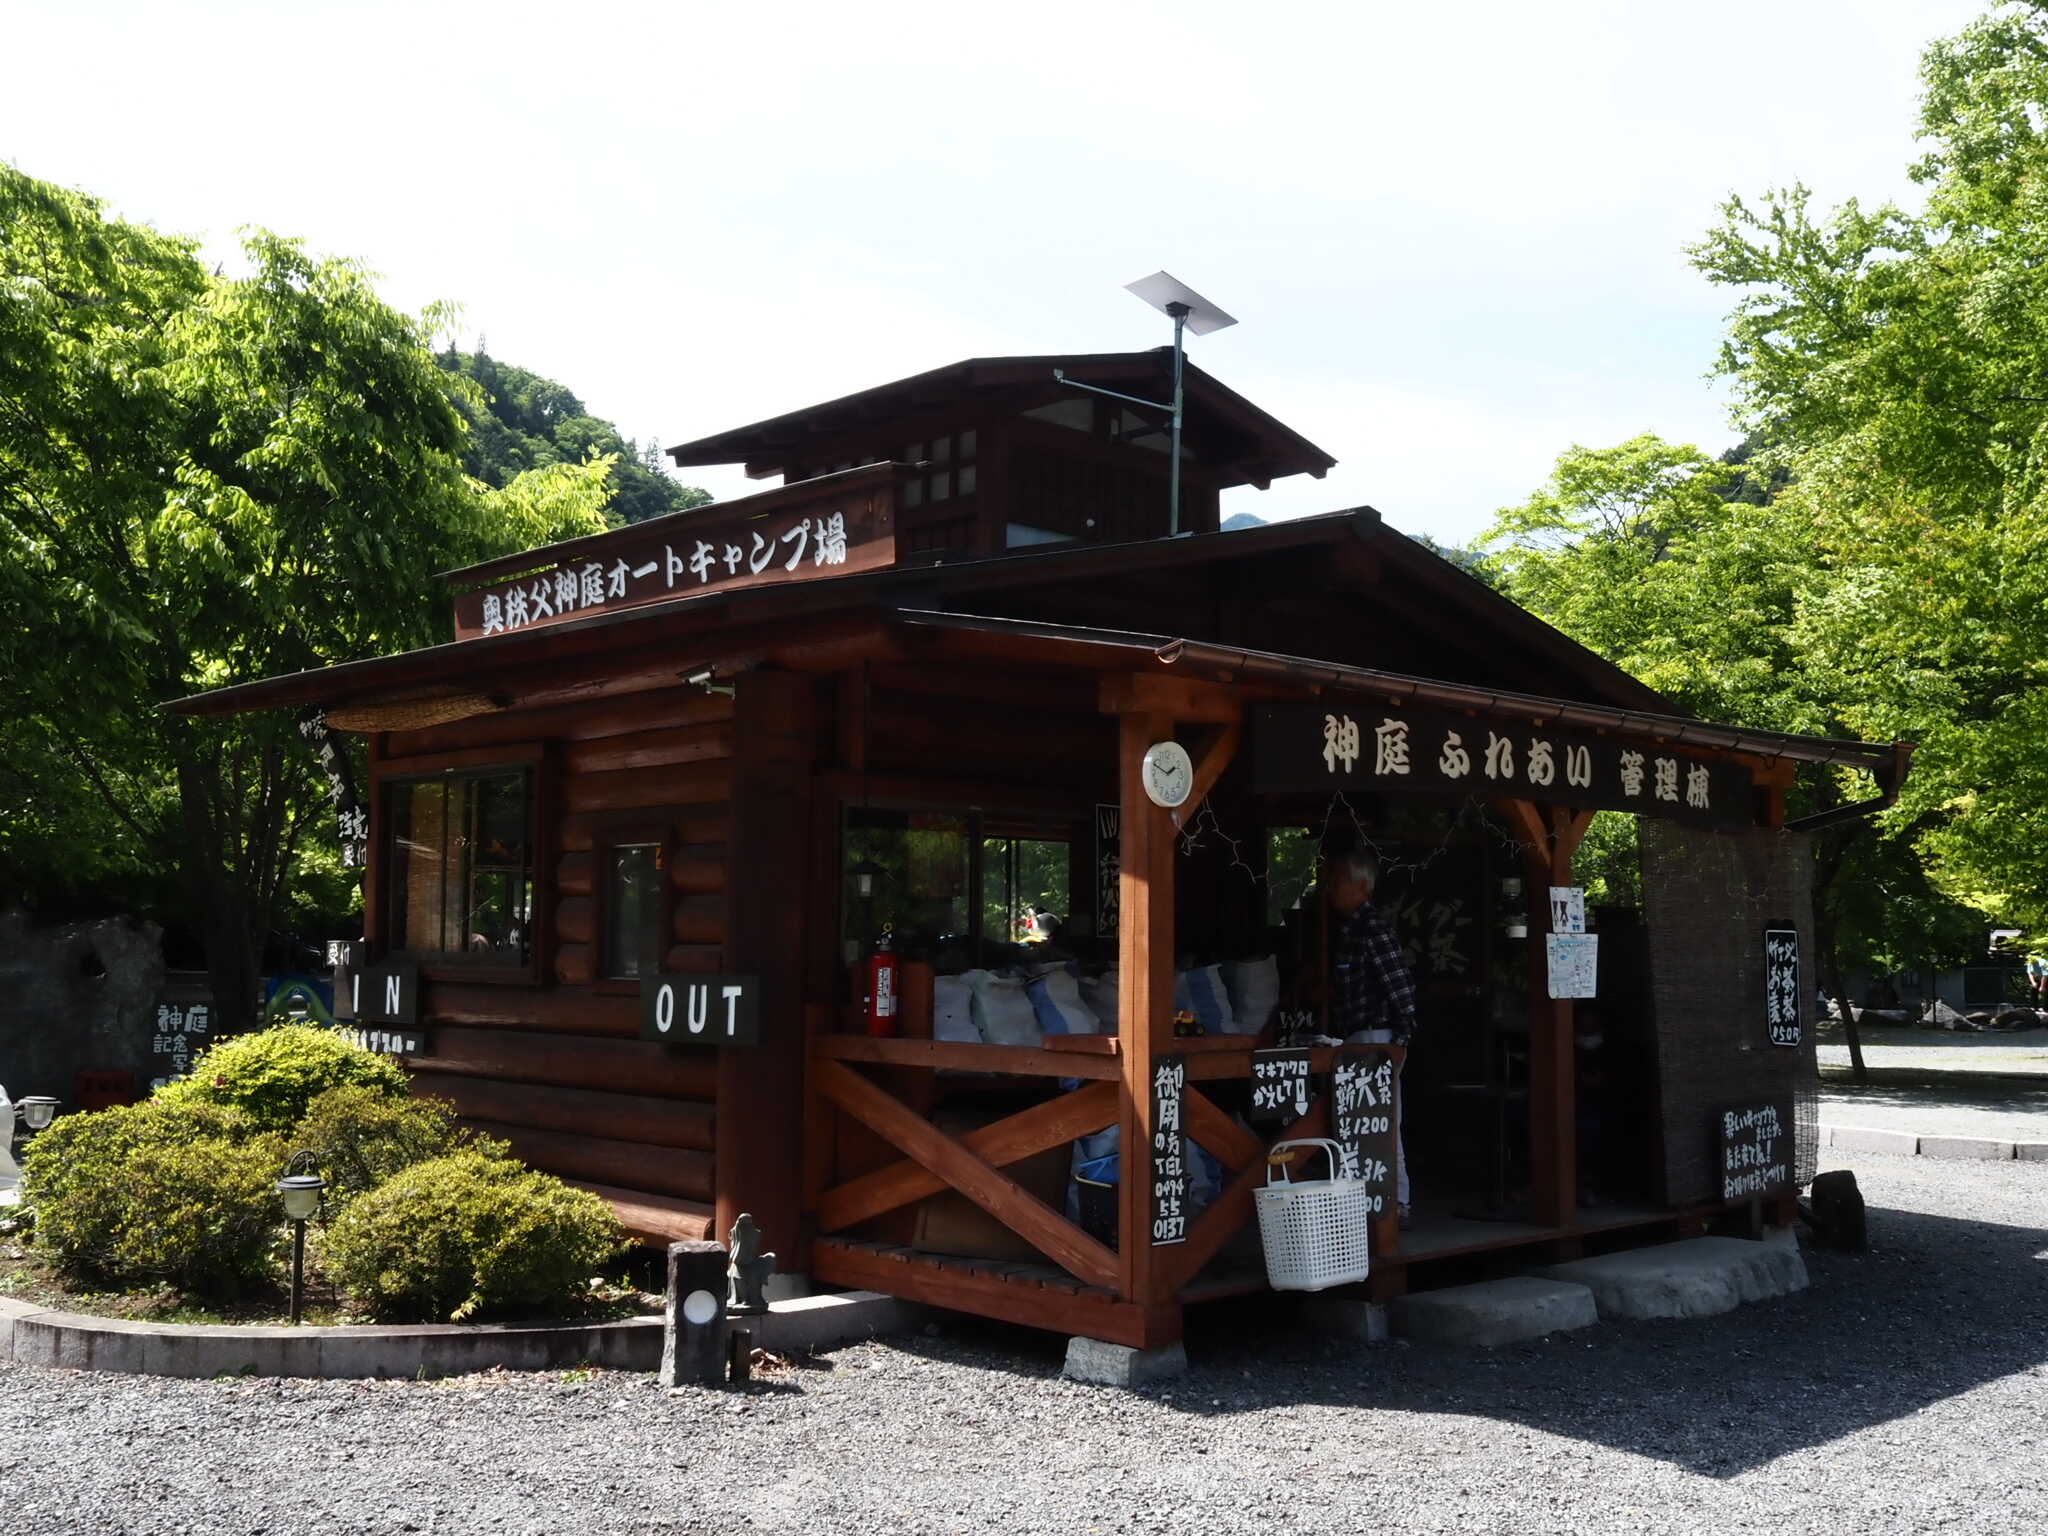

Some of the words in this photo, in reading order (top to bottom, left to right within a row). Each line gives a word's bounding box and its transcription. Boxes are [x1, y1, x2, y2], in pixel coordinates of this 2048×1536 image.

[482, 512, 848, 635] 奥秩父神庭オートキャンプ場
[1323, 714, 1411, 775] 神庭
[1439, 731, 1592, 789] ふれあい
[1620, 750, 1710, 809] 管理棟
[353, 973, 400, 1015] IN
[157, 1004, 208, 1033] 神庭
[656, 984, 742, 1036] OUT
[153, 1034, 188, 1053] 記念
[1339, 1116, 1389, 1141] ¥1200
[1155, 1156, 1183, 1176] TEL
[1155, 1179, 1184, 1197] 0494
[1160, 1199, 1181, 1217] 55
[1154, 1217, 1185, 1239] 0137
